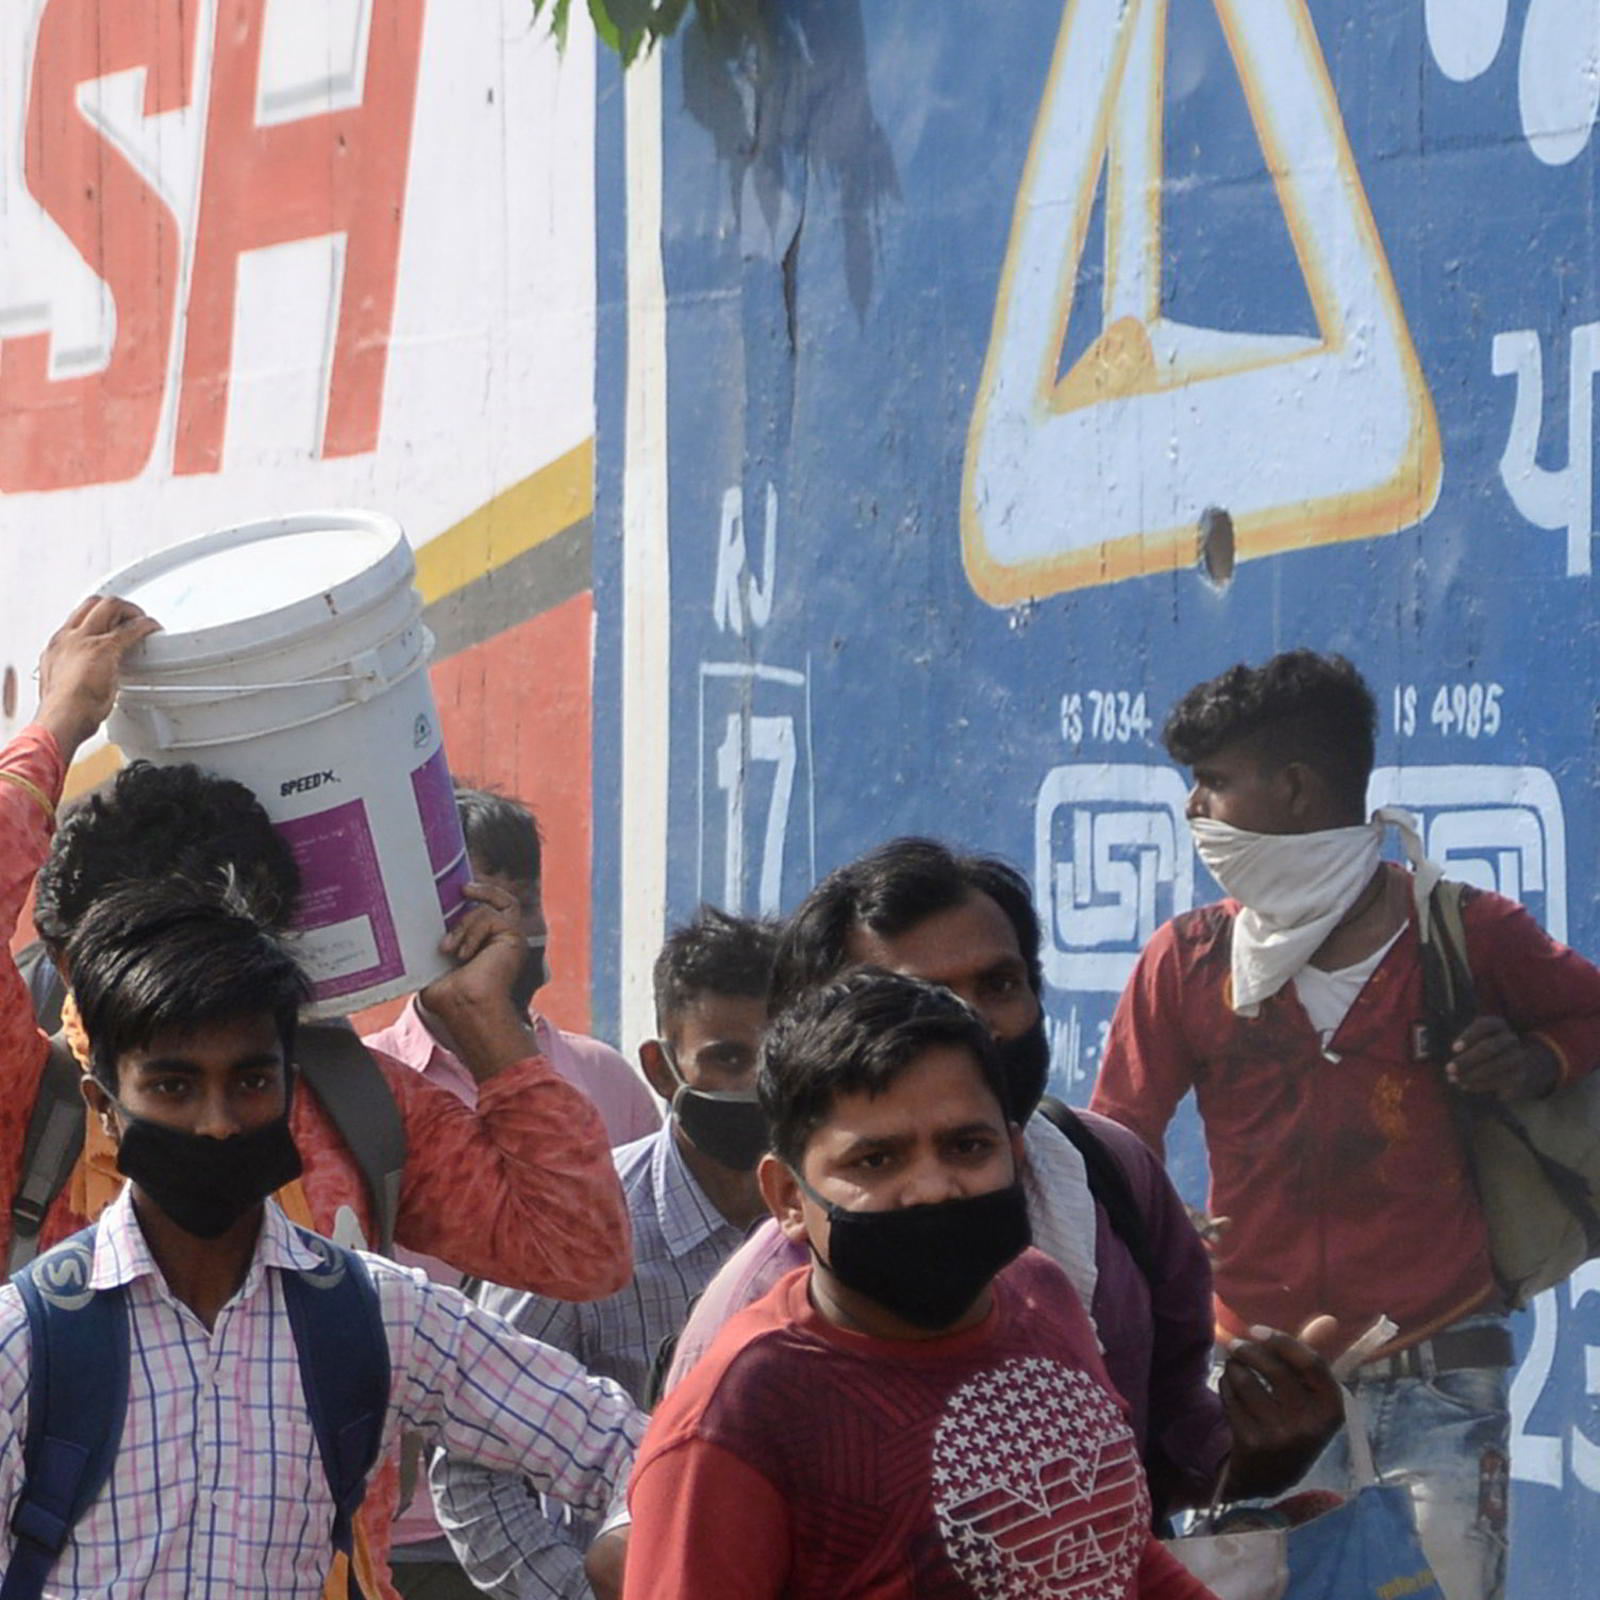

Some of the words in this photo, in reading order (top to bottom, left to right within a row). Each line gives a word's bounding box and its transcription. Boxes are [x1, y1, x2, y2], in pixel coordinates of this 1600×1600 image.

[1091, 689, 1152, 743] 7834
[1394, 685, 1416, 738] IS
[1431, 682, 1504, 740] 4985
[717, 713, 797, 920] 17
[1052, 1523, 1109, 1580] GA
